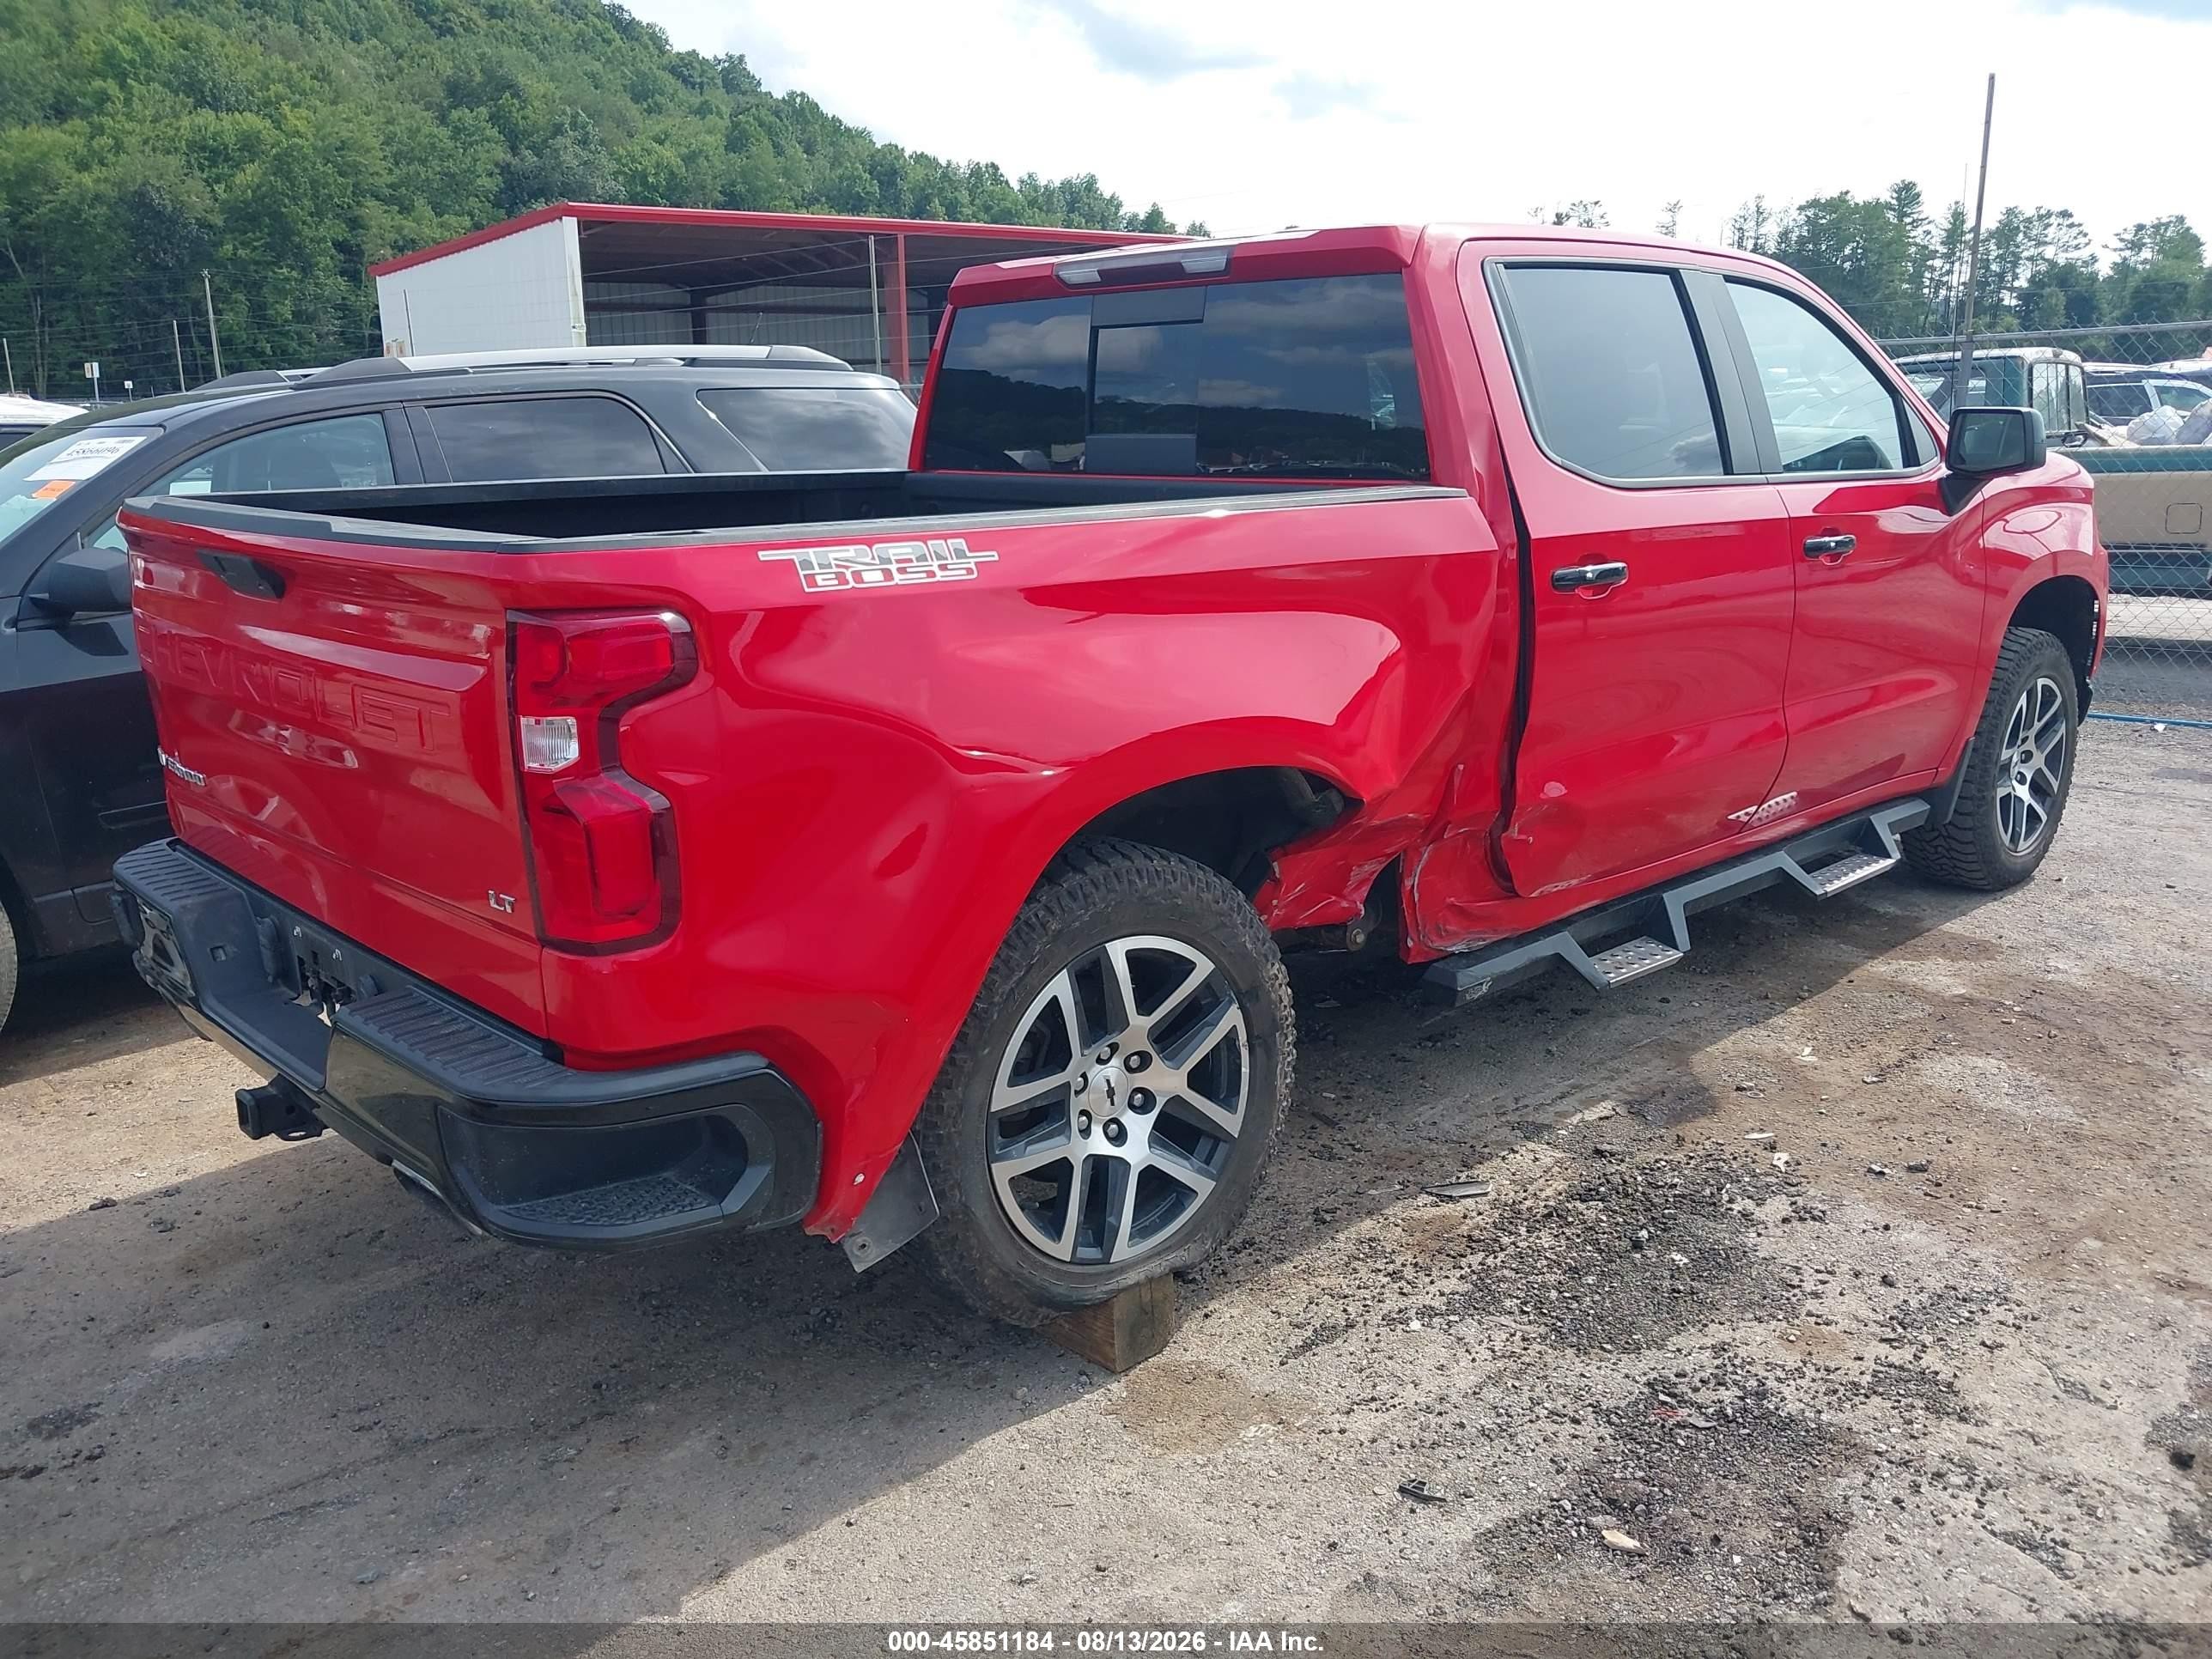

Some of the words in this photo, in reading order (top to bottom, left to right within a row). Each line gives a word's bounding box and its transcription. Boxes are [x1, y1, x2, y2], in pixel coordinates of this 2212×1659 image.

[757, 538, 999, 573] TRAIL
[799, 560, 978, 593] BOSS
[135, 622, 452, 755] CHEVROLET
[488, 890, 516, 914] LT
